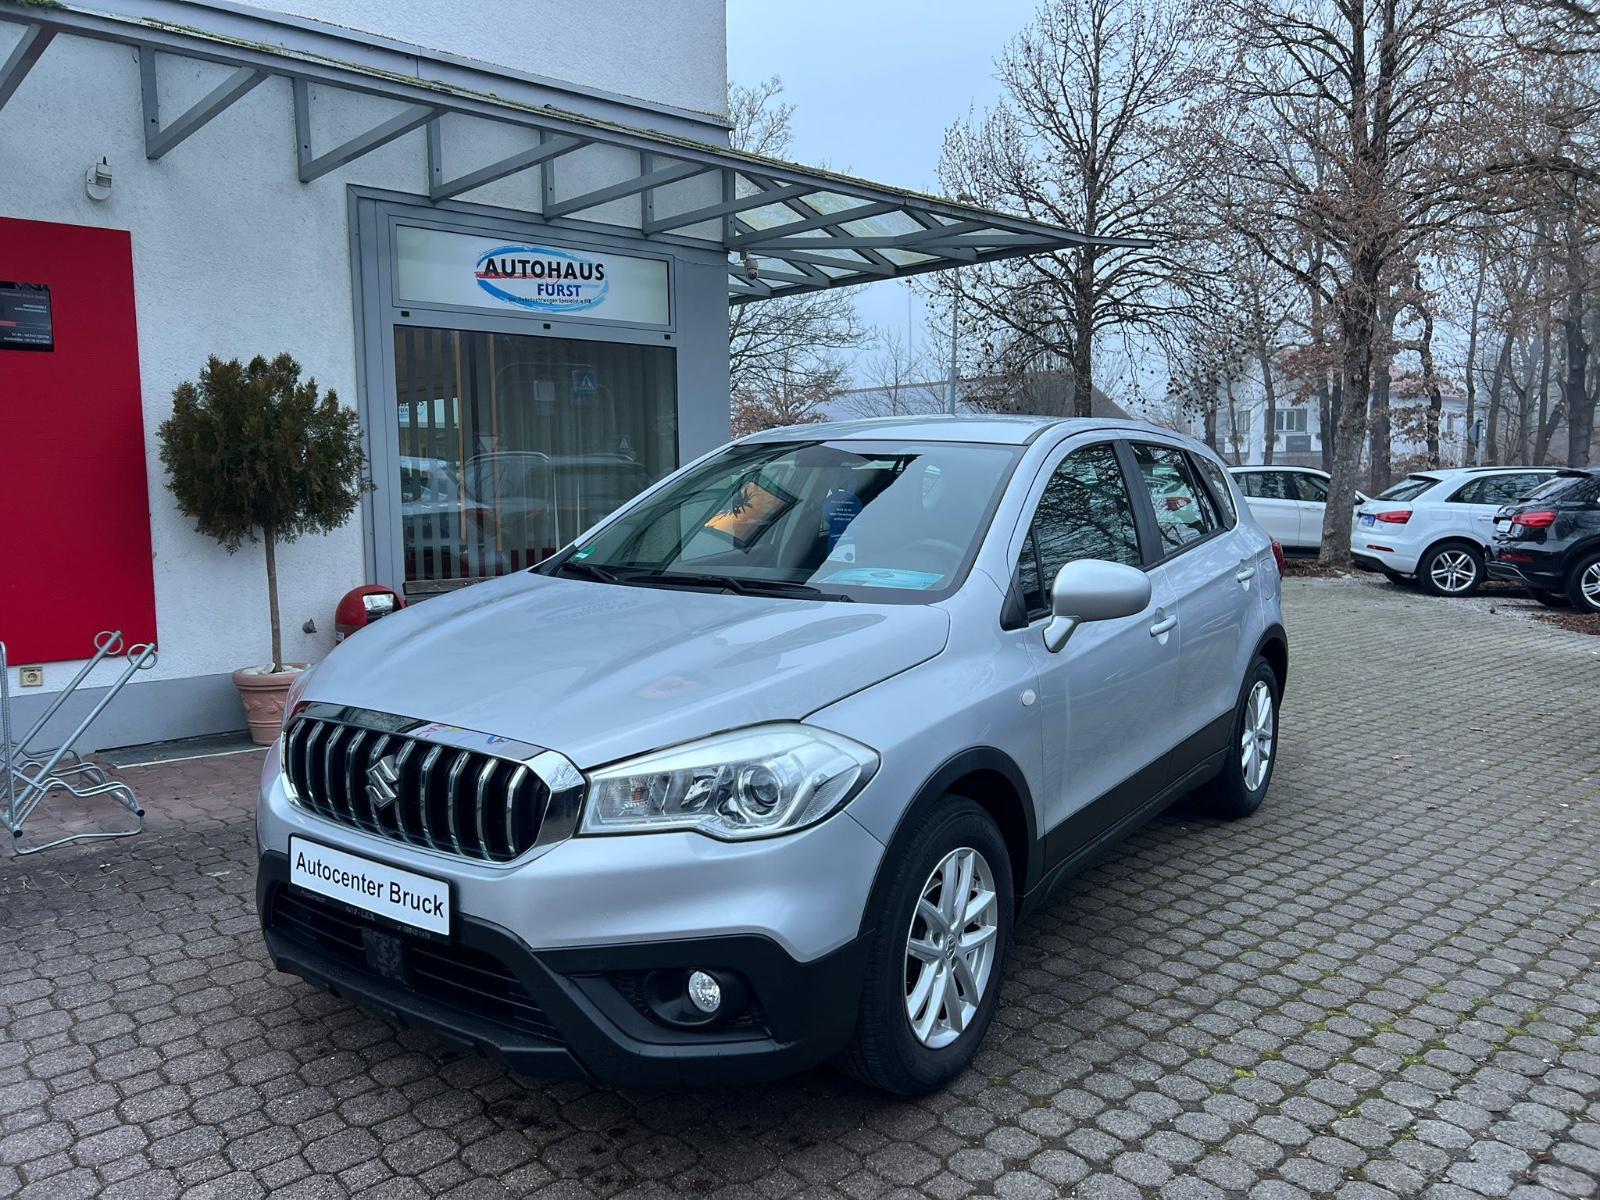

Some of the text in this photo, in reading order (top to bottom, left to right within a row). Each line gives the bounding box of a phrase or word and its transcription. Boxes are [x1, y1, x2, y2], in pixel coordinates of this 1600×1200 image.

[483, 258, 605, 281] AUTOHAUS
[296, 851, 444, 918] Autocenter Bruck
